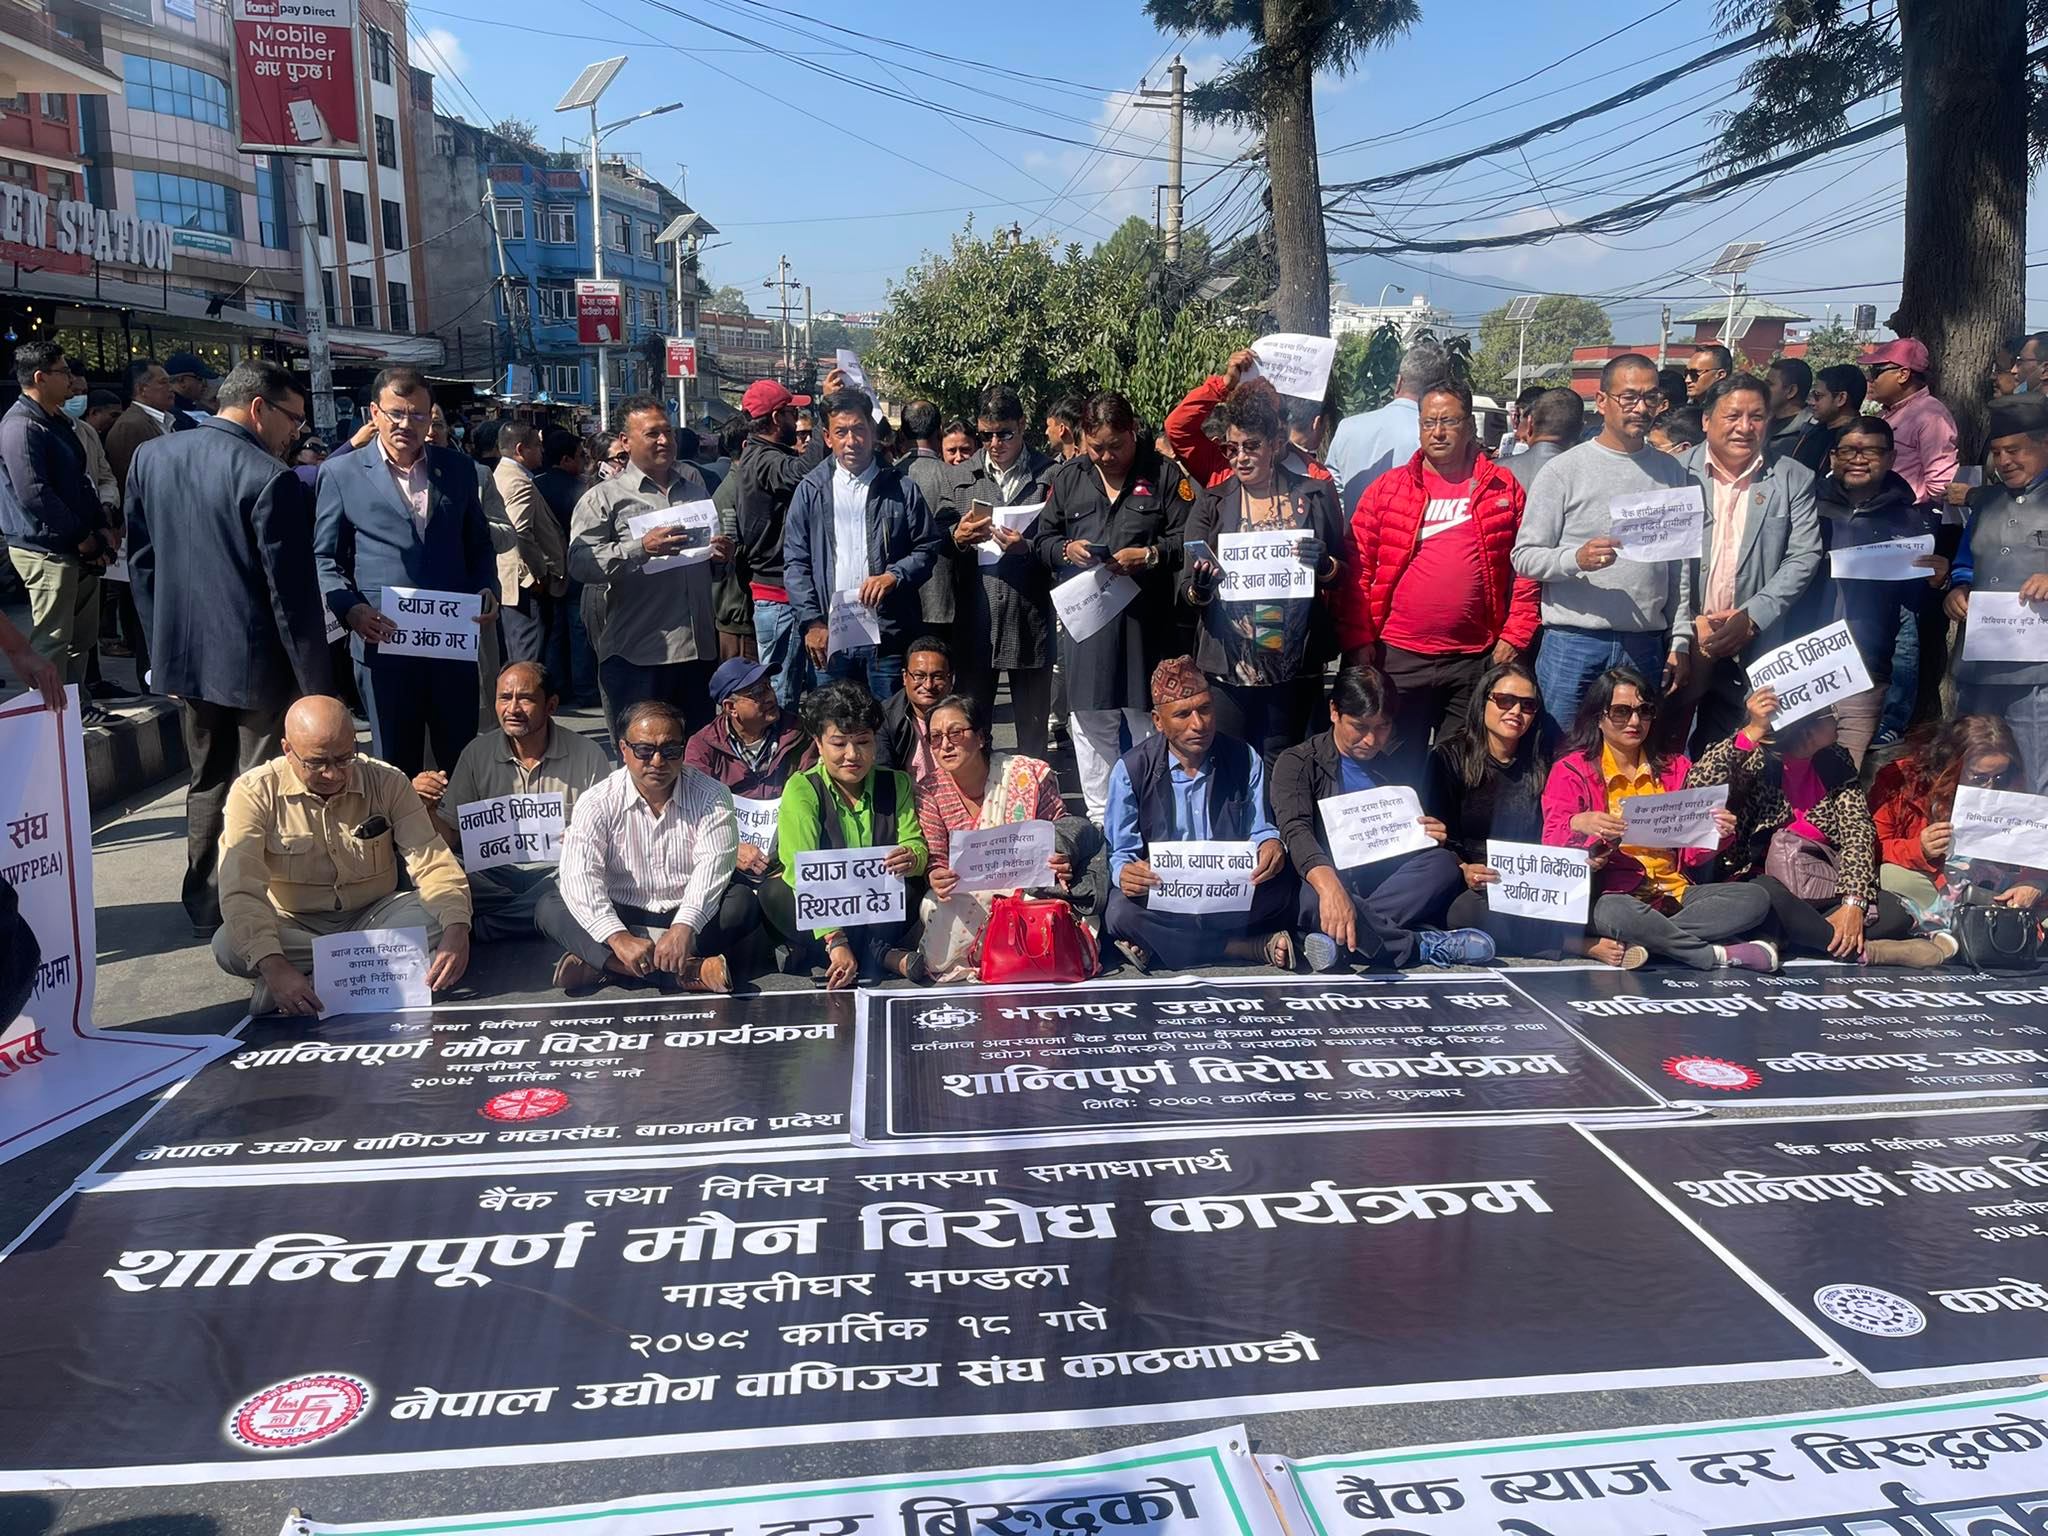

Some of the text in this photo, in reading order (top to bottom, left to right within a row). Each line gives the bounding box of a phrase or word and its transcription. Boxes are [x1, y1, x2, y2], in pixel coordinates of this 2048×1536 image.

[303, 5, 336, 17] Direct
[256, 24, 327, 44] Mobile
[249, 41, 336, 61] Number
[255, 60, 281, 76] भए
[57, 200, 174, 271] STATION
[1252, 545, 1268, 560] दर
[1242, 573, 1265, 590] खान
[398, 597, 461, 618] ब्याज दर
[412, 627, 468, 650] अंक गर
[1751, 629, 1852, 688] मनपरि प्रिमियम
[1811, 670, 1841, 695] गर
[460, 797, 562, 831] मनपरि प्रिमियम
[6, 812, 49, 850] संघ
[479, 833, 539, 859] बन्द गर
[801, 860, 848, 882] ब्याज
[1227, 850, 1254, 870] नबचे
[1490, 854, 1515, 875] चालू
[1540, 855, 1587, 879] निर्देशिका
[1156, 878, 1241, 899] अर्थतन्त्र बचदैन
[1503, 881, 1560, 905] स्थगित गर
[797, 887, 892, 920] स्थिरता देउ
[354, 943, 407, 956] दरमा स्थिरता
[348, 959, 389, 969] कायम गर
[349, 986, 389, 997] स्थगित गर
[1853, 988, 1985, 1009] विरोध
[998, 992, 1513, 1022] भक्तपुर उद्योग वाणिज्य संघ
[432, 1023, 471, 1033] तथा
[550, 1015, 616, 1028] समस्या
[623, 1009, 718, 1025] समाधानार्थ
[1822, 1012, 1995, 1027] माइतीघर मण्डला
[911, 1039, 976, 1051] वर्तमान
[983, 1035, 1066, 1048] अवस्थामा
[1112, 1032, 1149, 1042] तथा
[1328, 1023, 1424, 1036] अनावश्यक
[1510, 1022, 1548, 1032] तथा
[1887, 1027, 1963, 1040] कार्तिक
[2009, 1024, 2047, 1036] गते
[230, 1023, 840, 1070] शान्तिपूर्ण मौन विरोध कार्यक्रम
[979, 1048, 1032, 1060] उद्योग
[446, 1057, 624, 1074] माइतीघर मण्डला
[1757, 1051, 1944, 1073] ललितपुर
[1938, 1047, 2042, 1067] उद्योग
[486, 1070, 561, 1085] कार्तिक
[570, 1070, 601, 1080] १८
[612, 1066, 646, 1079] गते
[942, 1051, 1569, 1097] शान्तिपूर्ण विरोध कार्यक्रम
[1219, 1090, 1297, 1105] कार्तिक
[1303, 1090, 1332, 1101] १८
[135, 1140, 243, 1162] नेपाल
[248, 1136, 347, 1156] उद्योग
[353, 1130, 490, 1150] वाणिज्य
[635, 1116, 760, 1138] बागमति
[768, 1111, 844, 1131] प्रदेश
[1824, 1142, 1872, 1154] तथा
[1948, 1133, 2024, 1148] समस्या
[478, 1147, 1233, 1212] बैंक तथा वित्तिय समस्या समाधानार्थ
[1672, 1165, 1908, 1208] शान्तिपूर्ण
[1895, 1160, 2012, 1194] मौन
[102, 1179, 1554, 1292] शान्तिपूर्ण मौन विरोध कार्यक्रम
[662, 1263, 1071, 1310] माइतीघर मण्डला
[778, 1310, 930, 1347] कार्तिक
[957, 1315, 1012, 1339] १८
[1039, 1300, 1109, 1333] गते
[389, 1386, 559, 1422] नेपाल
[571, 1372, 720, 1410] उद्योग
[736, 1360, 942, 1400] वाणिज्य
[957, 1353, 1046, 1385] संघ
[1060, 1330, 1321, 1380] काठमाण्डौ
[1481, 1458, 1672, 1505] ब्याज
[1676, 1447, 1796, 1488] दर
